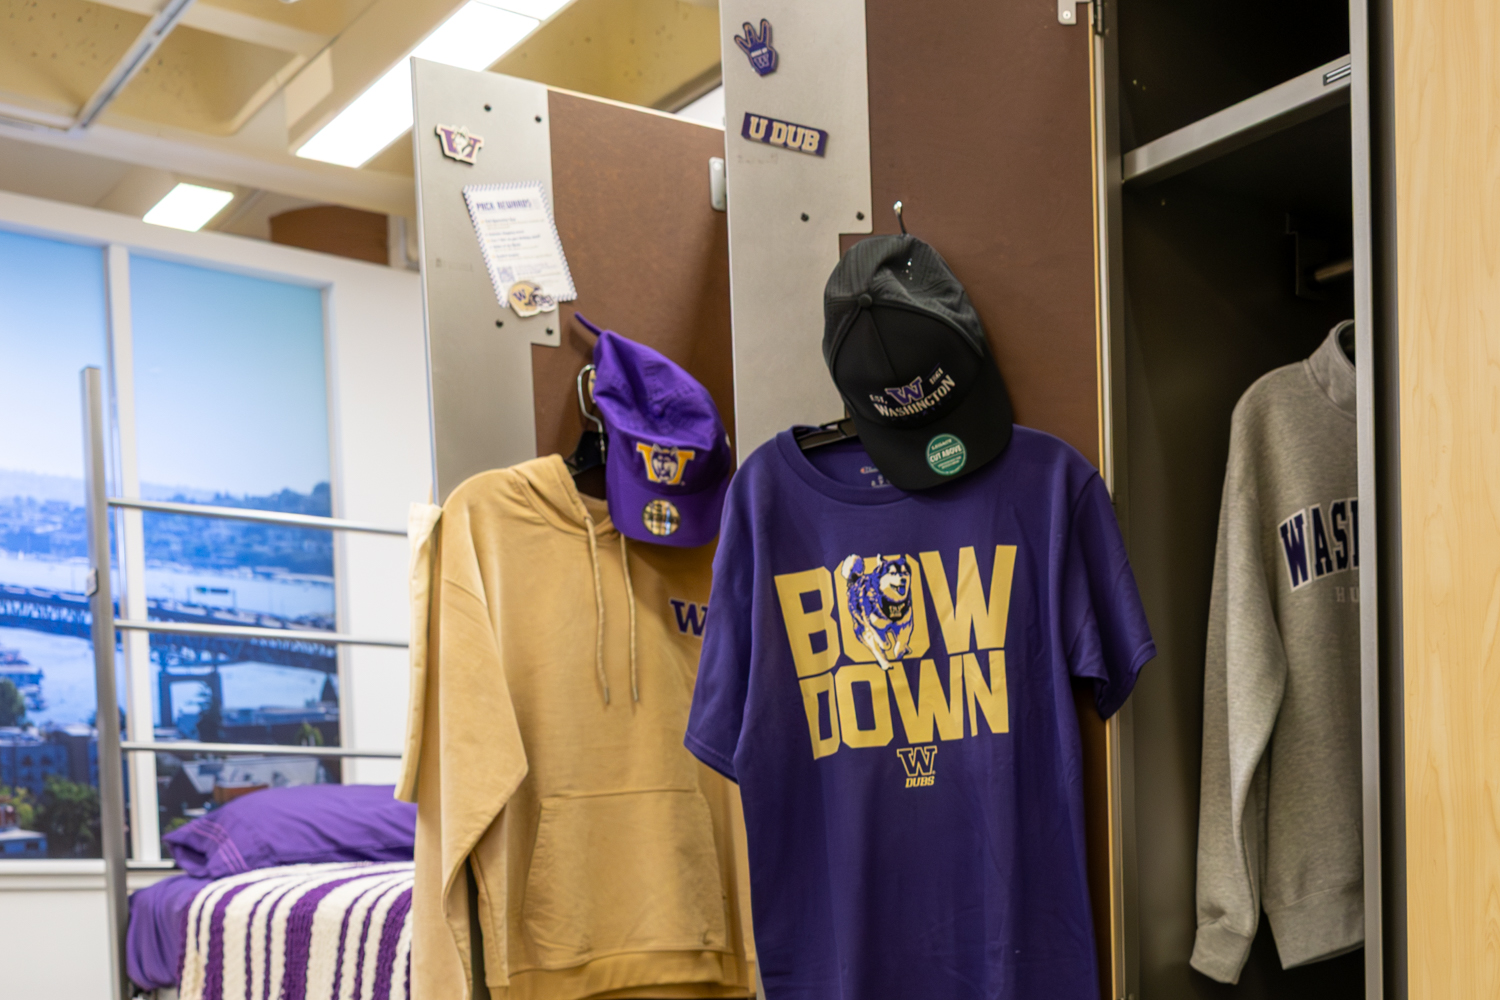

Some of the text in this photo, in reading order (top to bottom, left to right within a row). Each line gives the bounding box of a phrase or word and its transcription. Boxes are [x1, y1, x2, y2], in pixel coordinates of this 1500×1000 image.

[749, 115, 820, 152] U DUB
[512, 288, 527, 303] W
[873, 374, 956, 417] WASHINGTON
[884, 376, 924, 406] W
[669, 598, 708, 637] W
[774, 544, 1017, 678] BOW
[799, 650, 1009, 760] DOWN
[897, 745, 937, 776] W
[905, 776, 935, 788] DUBS
